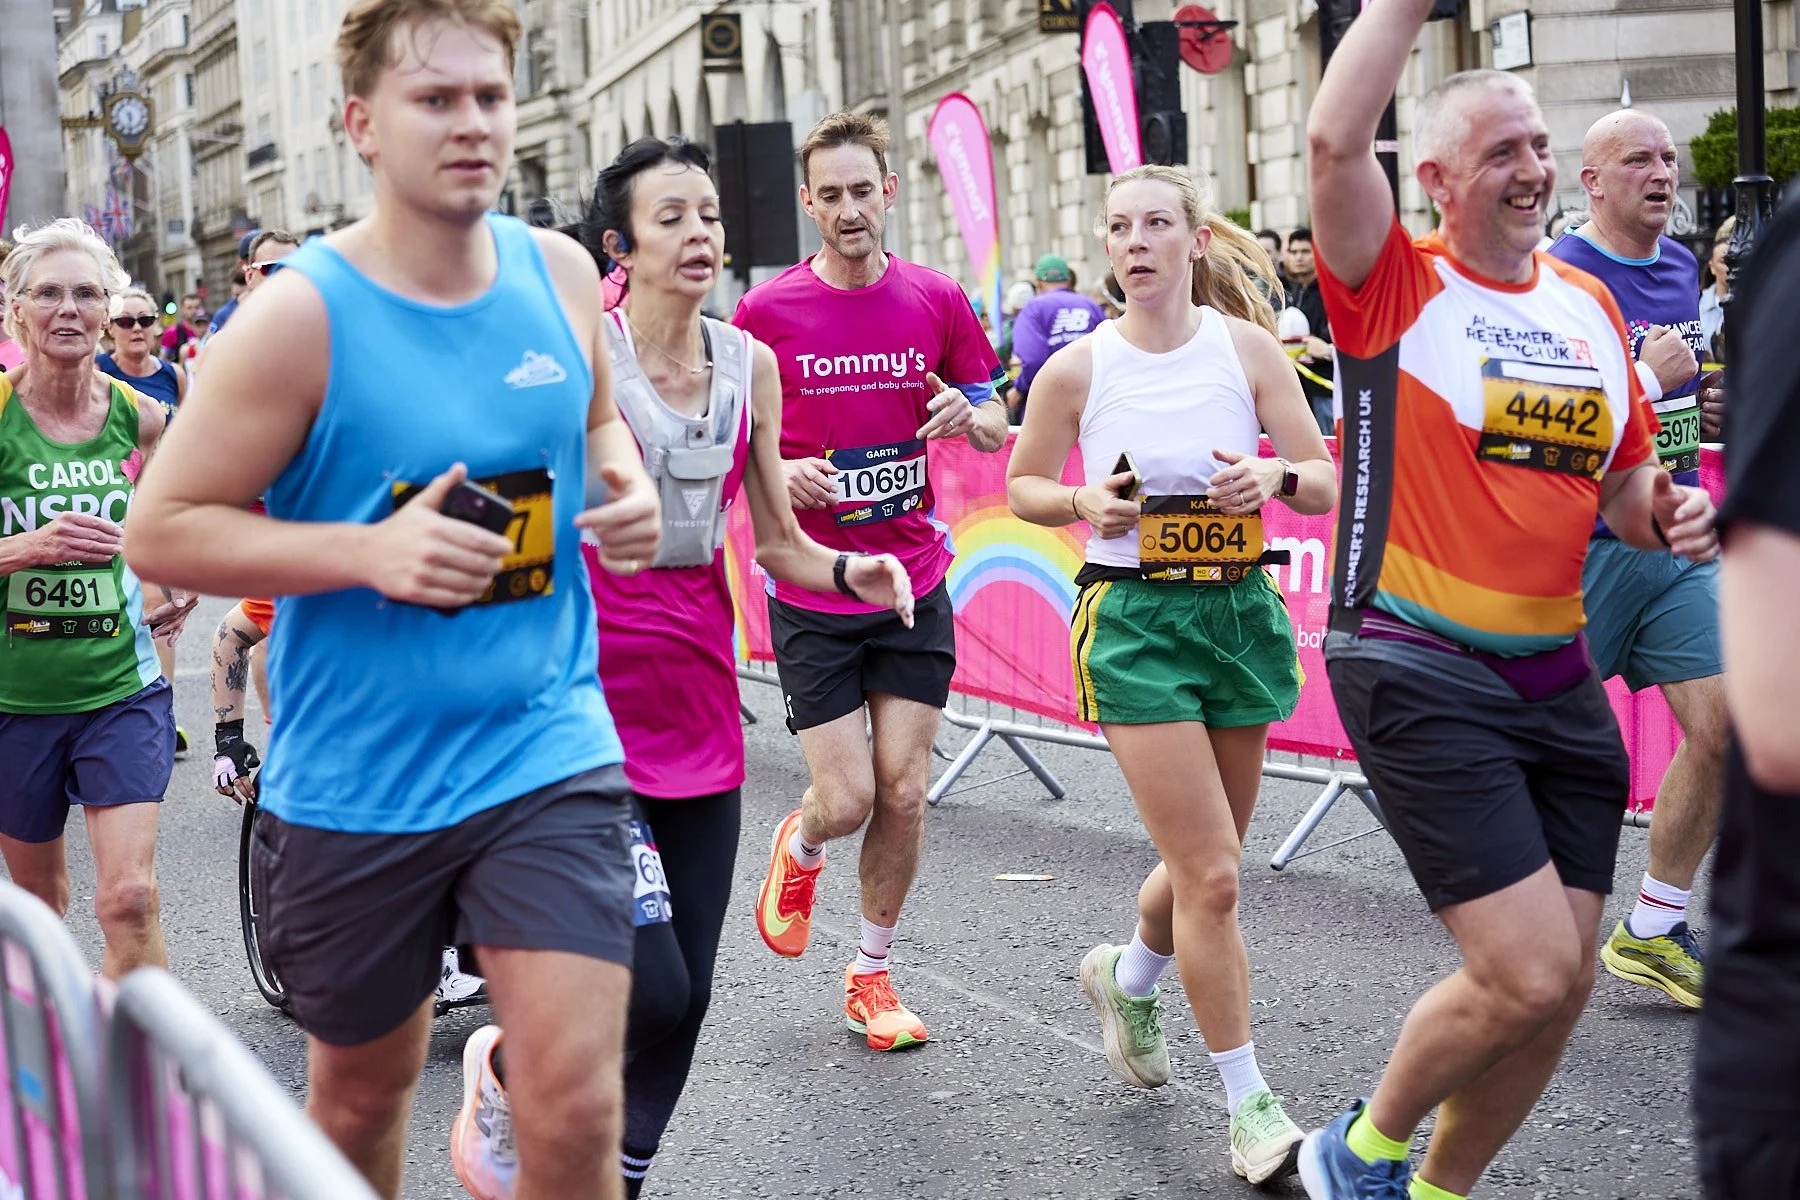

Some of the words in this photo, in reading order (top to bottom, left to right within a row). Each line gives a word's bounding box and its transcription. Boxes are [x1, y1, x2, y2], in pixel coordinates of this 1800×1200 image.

[795, 347, 926, 378] Tommy's
[800, 388, 815, 396] The
[816, 384, 860, 396] pregnancy
[861, 381, 877, 390] and
[879, 381, 900, 390] baby
[1358, 388, 1373, 417] UK
[1505, 390, 1600, 438] 4442
[1656, 415, 1699, 449] 5973
[866, 447, 899, 459] GARTH
[28, 459, 123, 490] CAROL
[837, 460, 919, 498] 10691
[1353, 419, 1372, 520] RESEARCH
[1, 489, 135, 535] NSPC
[1159, 522, 1247, 553] 5064
[25, 577, 100, 608] 6491
